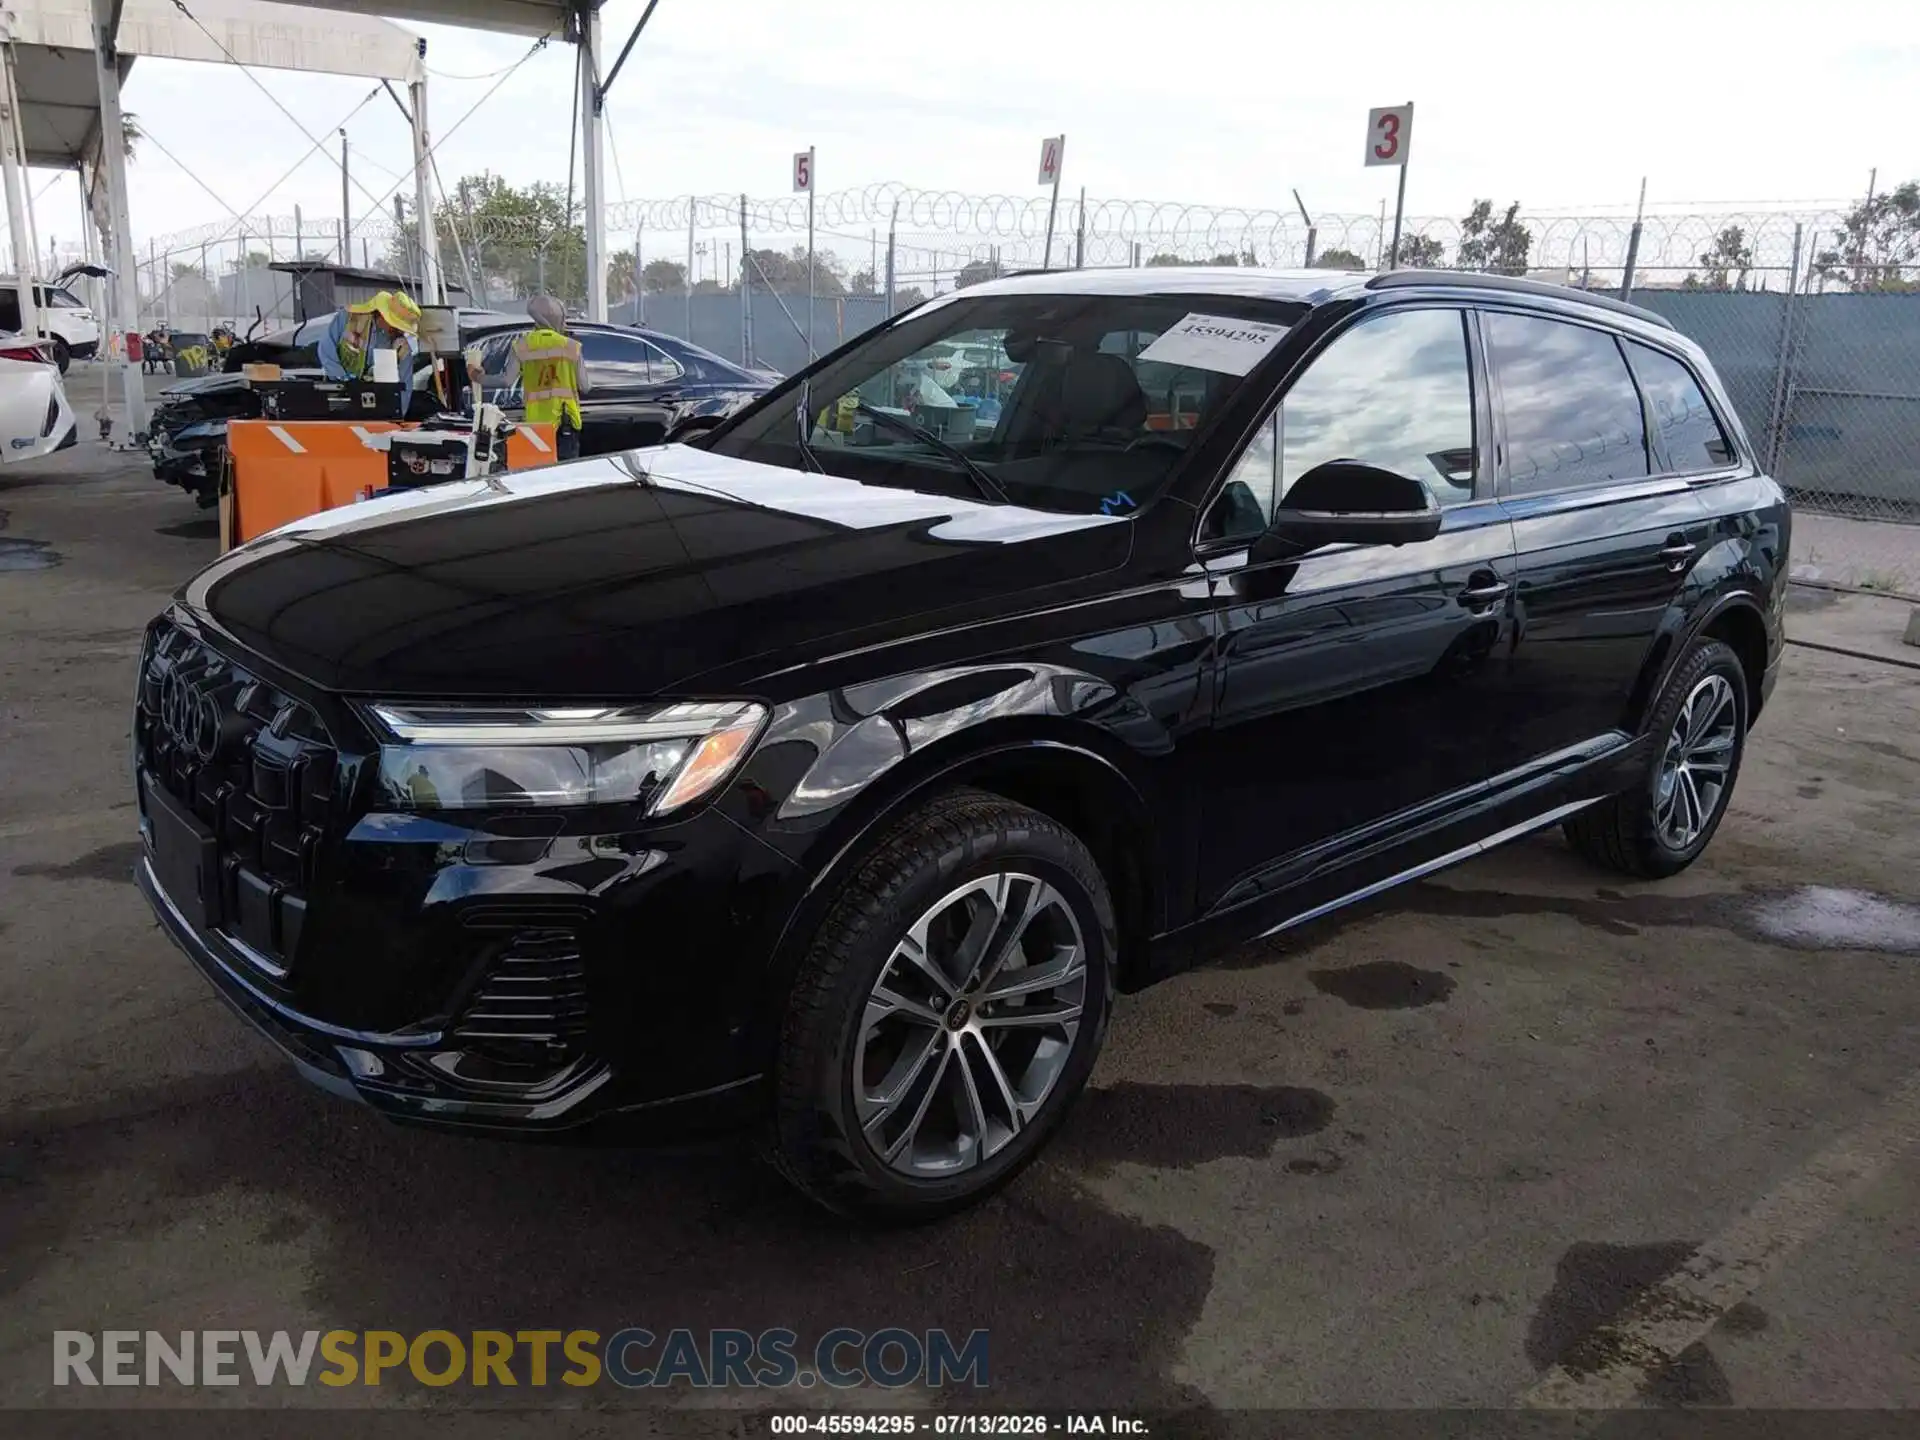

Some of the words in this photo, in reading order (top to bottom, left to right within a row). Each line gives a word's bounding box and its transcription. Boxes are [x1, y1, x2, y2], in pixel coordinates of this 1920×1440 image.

[1374, 113, 1400, 160] 3
[797, 157, 809, 188] 5
[1043, 142, 1056, 180] 4
[1181, 324, 1270, 345] 45594295
